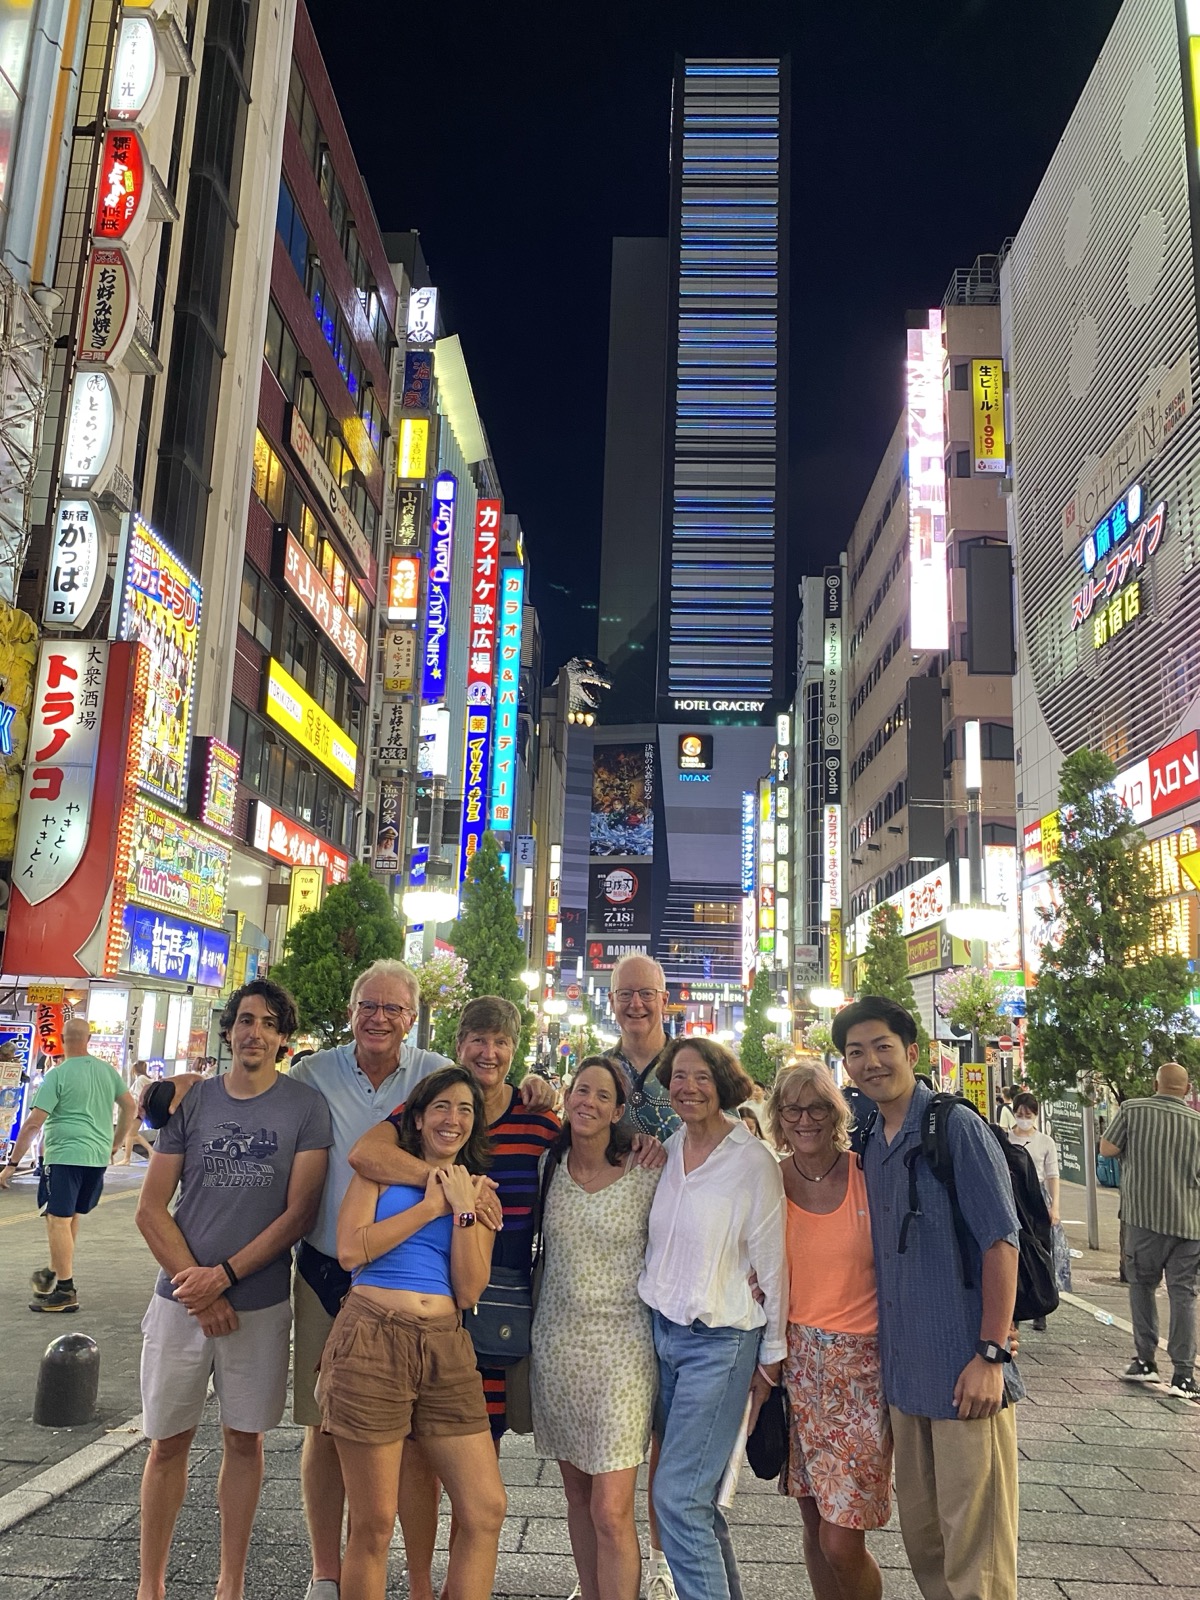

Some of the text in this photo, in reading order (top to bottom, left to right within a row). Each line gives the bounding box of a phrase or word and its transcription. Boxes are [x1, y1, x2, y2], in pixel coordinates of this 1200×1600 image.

[91, 267, 117, 349] お好み焼き
[416, 297, 432, 333] ダーツ
[979, 365, 995, 455] 生ビール 199円
[1163, 403, 1186, 437] HOOKAH
[1165, 388, 1186, 421] SHISHA
[297, 423, 308, 460] 3F
[69, 476, 90, 487] 1F
[61, 510, 89, 521] 新宿
[399, 491, 417, 539] 山内農場
[433, 501, 452, 536] City
[1095, 502, 1128, 557] 麻雀
[58, 523, 86, 592] かっぱ
[287, 545, 299, 578] 5F
[1070, 502, 1166, 632] スリーファイブ
[52, 601, 75, 614] B1
[158, 565, 197, 631] キラリ
[470, 506, 499, 674] カラオケ歌広場
[826, 575, 840, 612] Booth
[298, 561, 358, 666] 山内農場
[426, 594, 444, 667] SHINJUKU
[1093, 582, 1141, 649] 新宿店
[828, 622, 837, 708] ネットカフェ & カプセル
[76, 646, 103, 730] 大衆酒場
[392, 680, 406, 689] 3F
[495, 579, 520, 820] カラオケ&パーティー館
[472, 718, 485, 730] 薬
[675, 700, 765, 711] HOTEL GRACERY
[29, 655, 78, 800] トラノコ
[380, 748, 407, 759] 大阪家
[466, 738, 486, 823] マツモトキヨシ
[679, 774, 711, 782] IMAX
[826, 756, 840, 795] Booth
[382, 784, 398, 824] 海の家
[22, 815, 57, 878] やきとん
[50, 802, 80, 865] やきとり
[828, 814, 838, 849] カラオケ
[603, 912, 631, 923] 7.18
[941, 934, 950, 958] 2F
[691, 992, 715, 1001] TOHO
[797, 974, 817, 982] DAN
[30, 993, 54, 1002] かっぱ
[38, 1004, 56, 1052] 立呑み
[215, 1174, 273, 1188] LIBRAS
